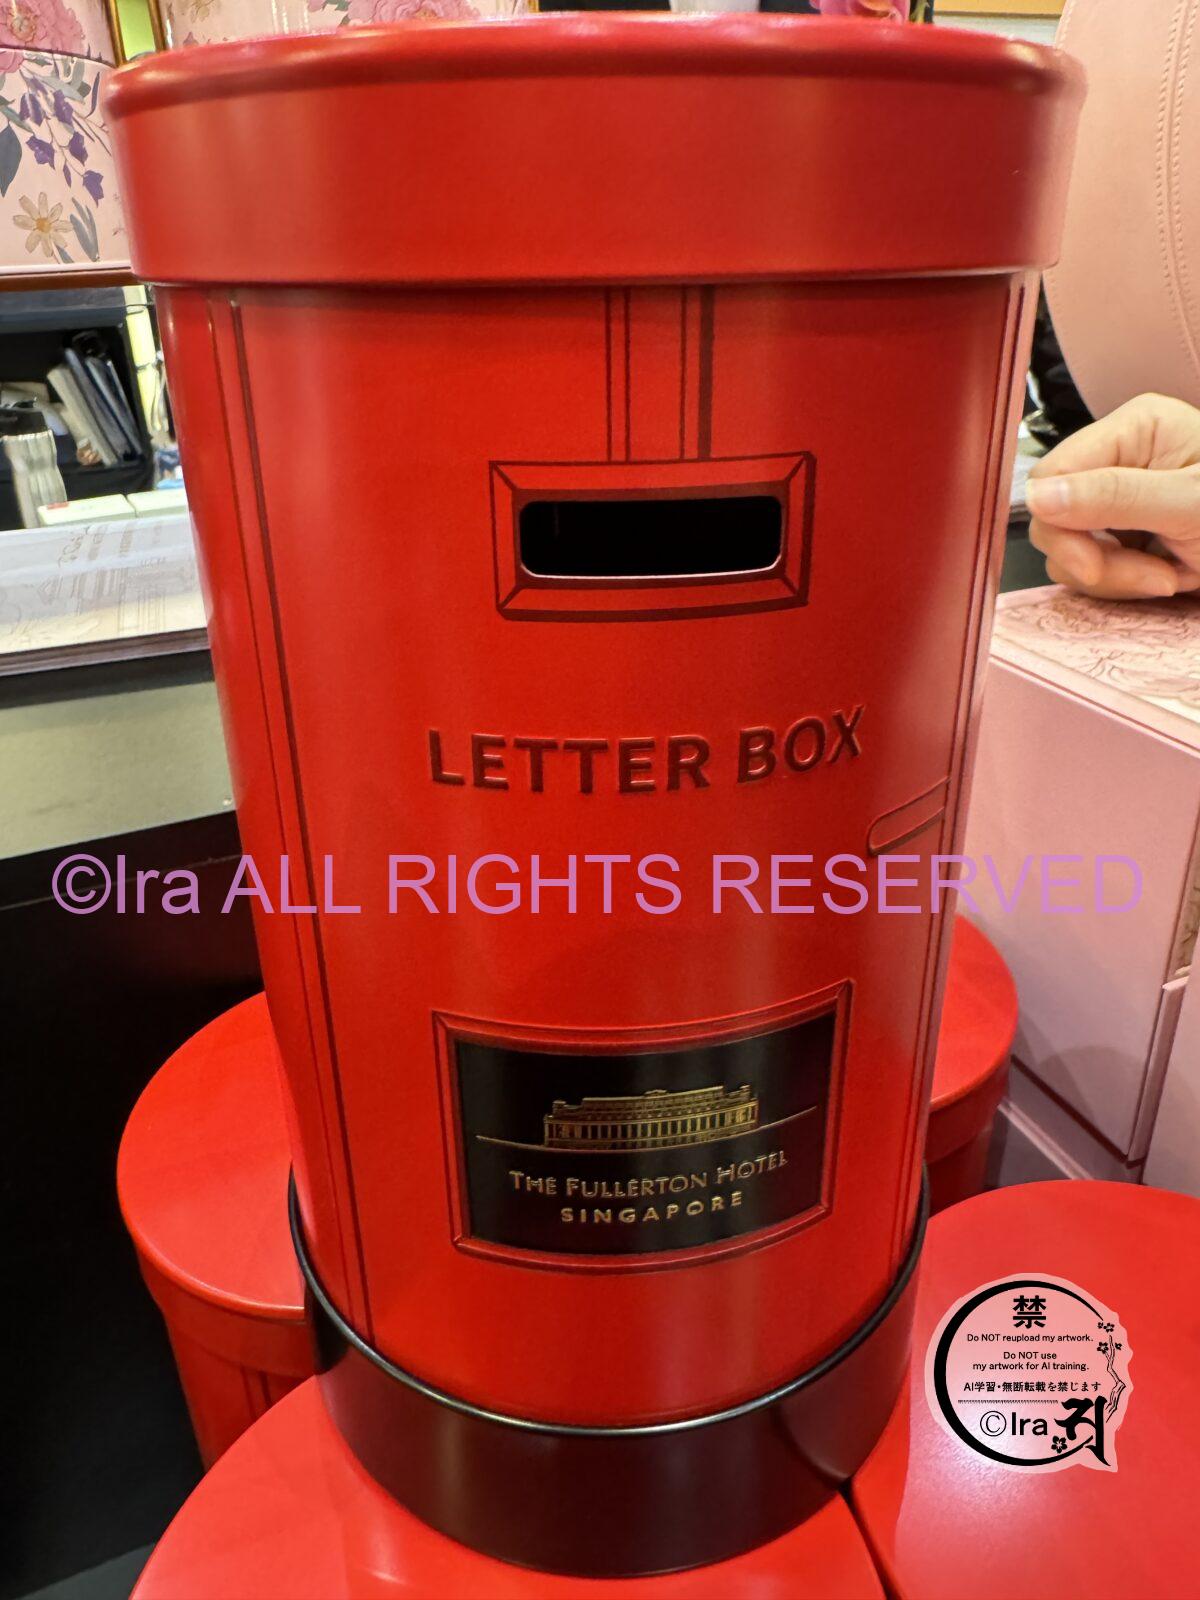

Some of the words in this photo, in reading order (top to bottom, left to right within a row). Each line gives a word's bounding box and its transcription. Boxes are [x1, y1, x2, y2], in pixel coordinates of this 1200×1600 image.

[429, 728, 710, 793] LETTER
[737, 704, 865, 784] BOX
[509, 1171, 557, 1196] THE
[566, 1172, 708, 1198] FULLERTON
[716, 1150, 788, 1185] HOTEL
[561, 1191, 743, 1224] SINGAPORE
